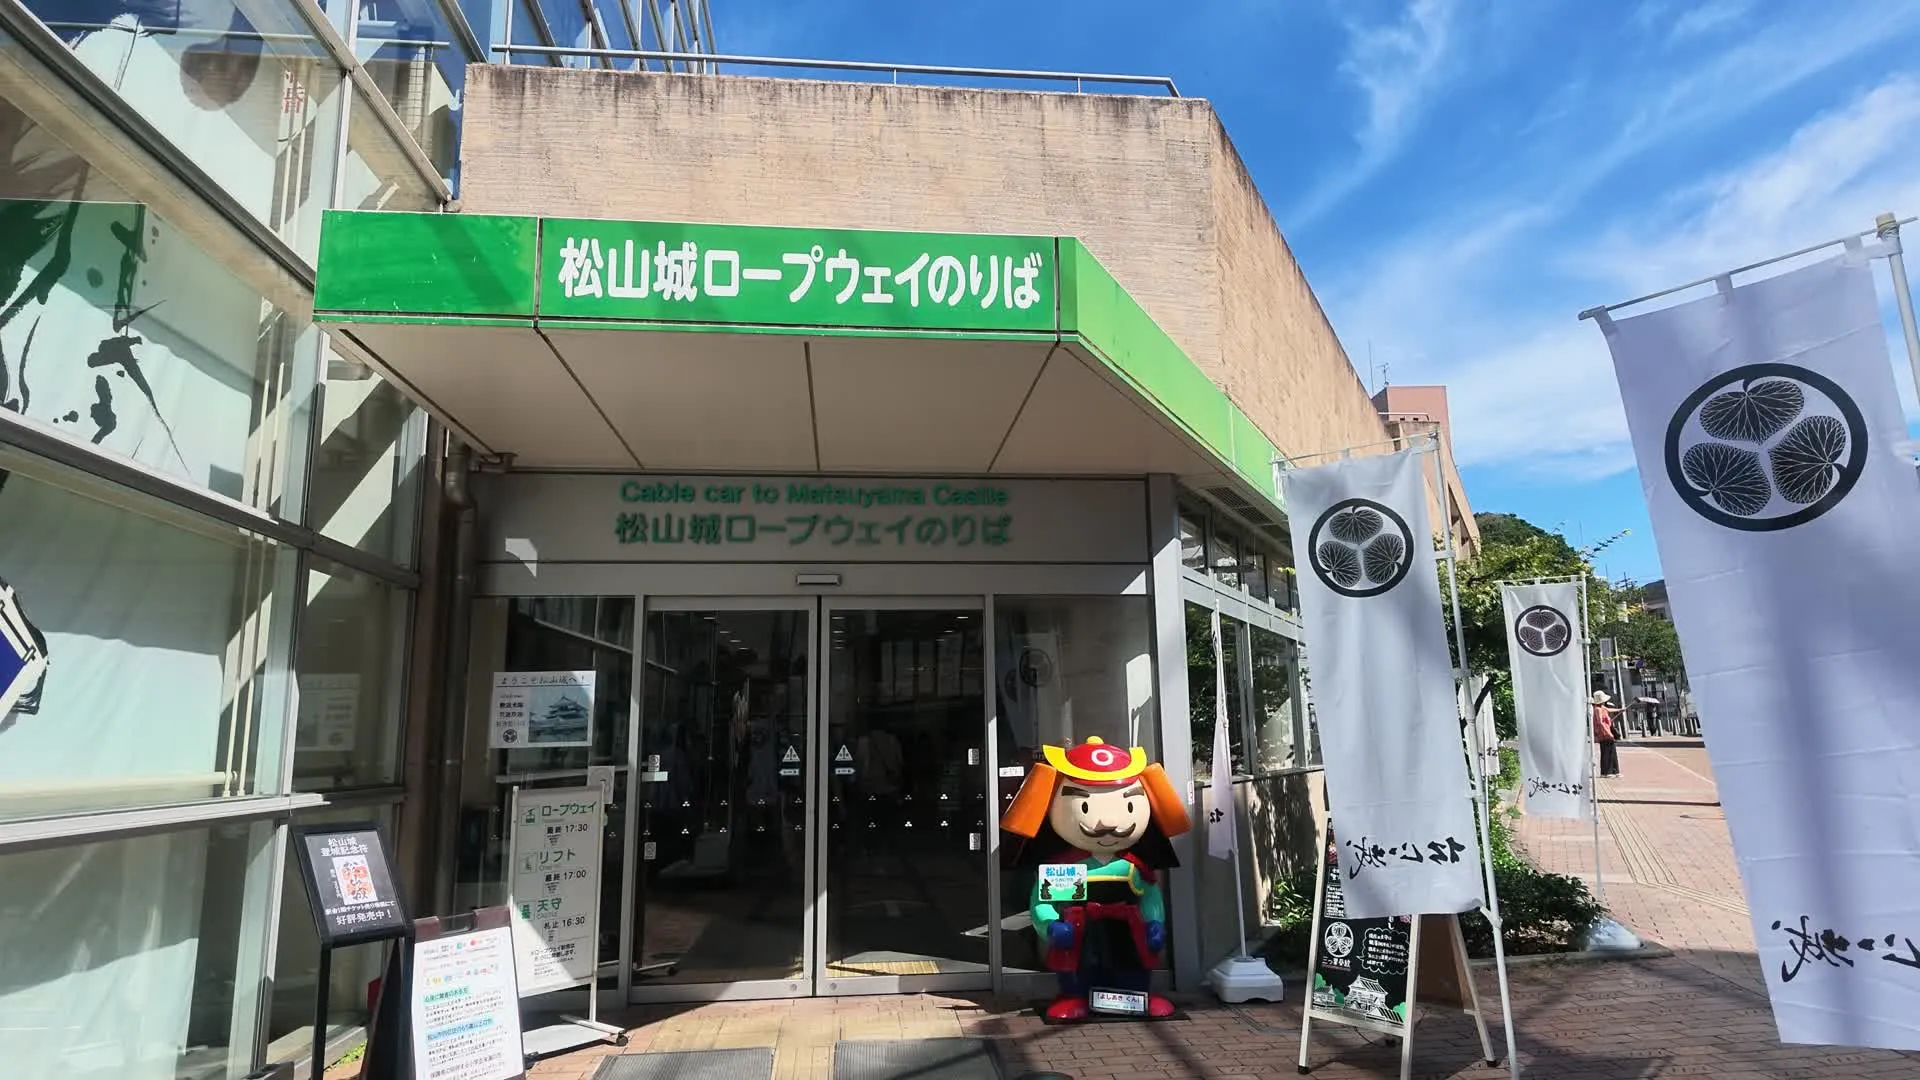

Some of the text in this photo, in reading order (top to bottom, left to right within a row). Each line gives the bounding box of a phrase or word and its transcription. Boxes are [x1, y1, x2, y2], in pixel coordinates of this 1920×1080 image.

[558, 237, 1043, 309] 松山城ロープウェイのりば
[621, 480, 1010, 508] Cable car to Matsuyama Castle
[615, 511, 1012, 547] 松山城ロープウェイのりば
[541, 801, 597, 817] ロープウェイ
[565, 823, 588, 833] 17:30
[539, 848, 576, 865] リフト
[563, 869, 587, 880] 17:00
[537, 897, 562, 913] 天守
[335, 908, 393, 926] 好評発売中！
[562, 916, 586, 927] 16:30
